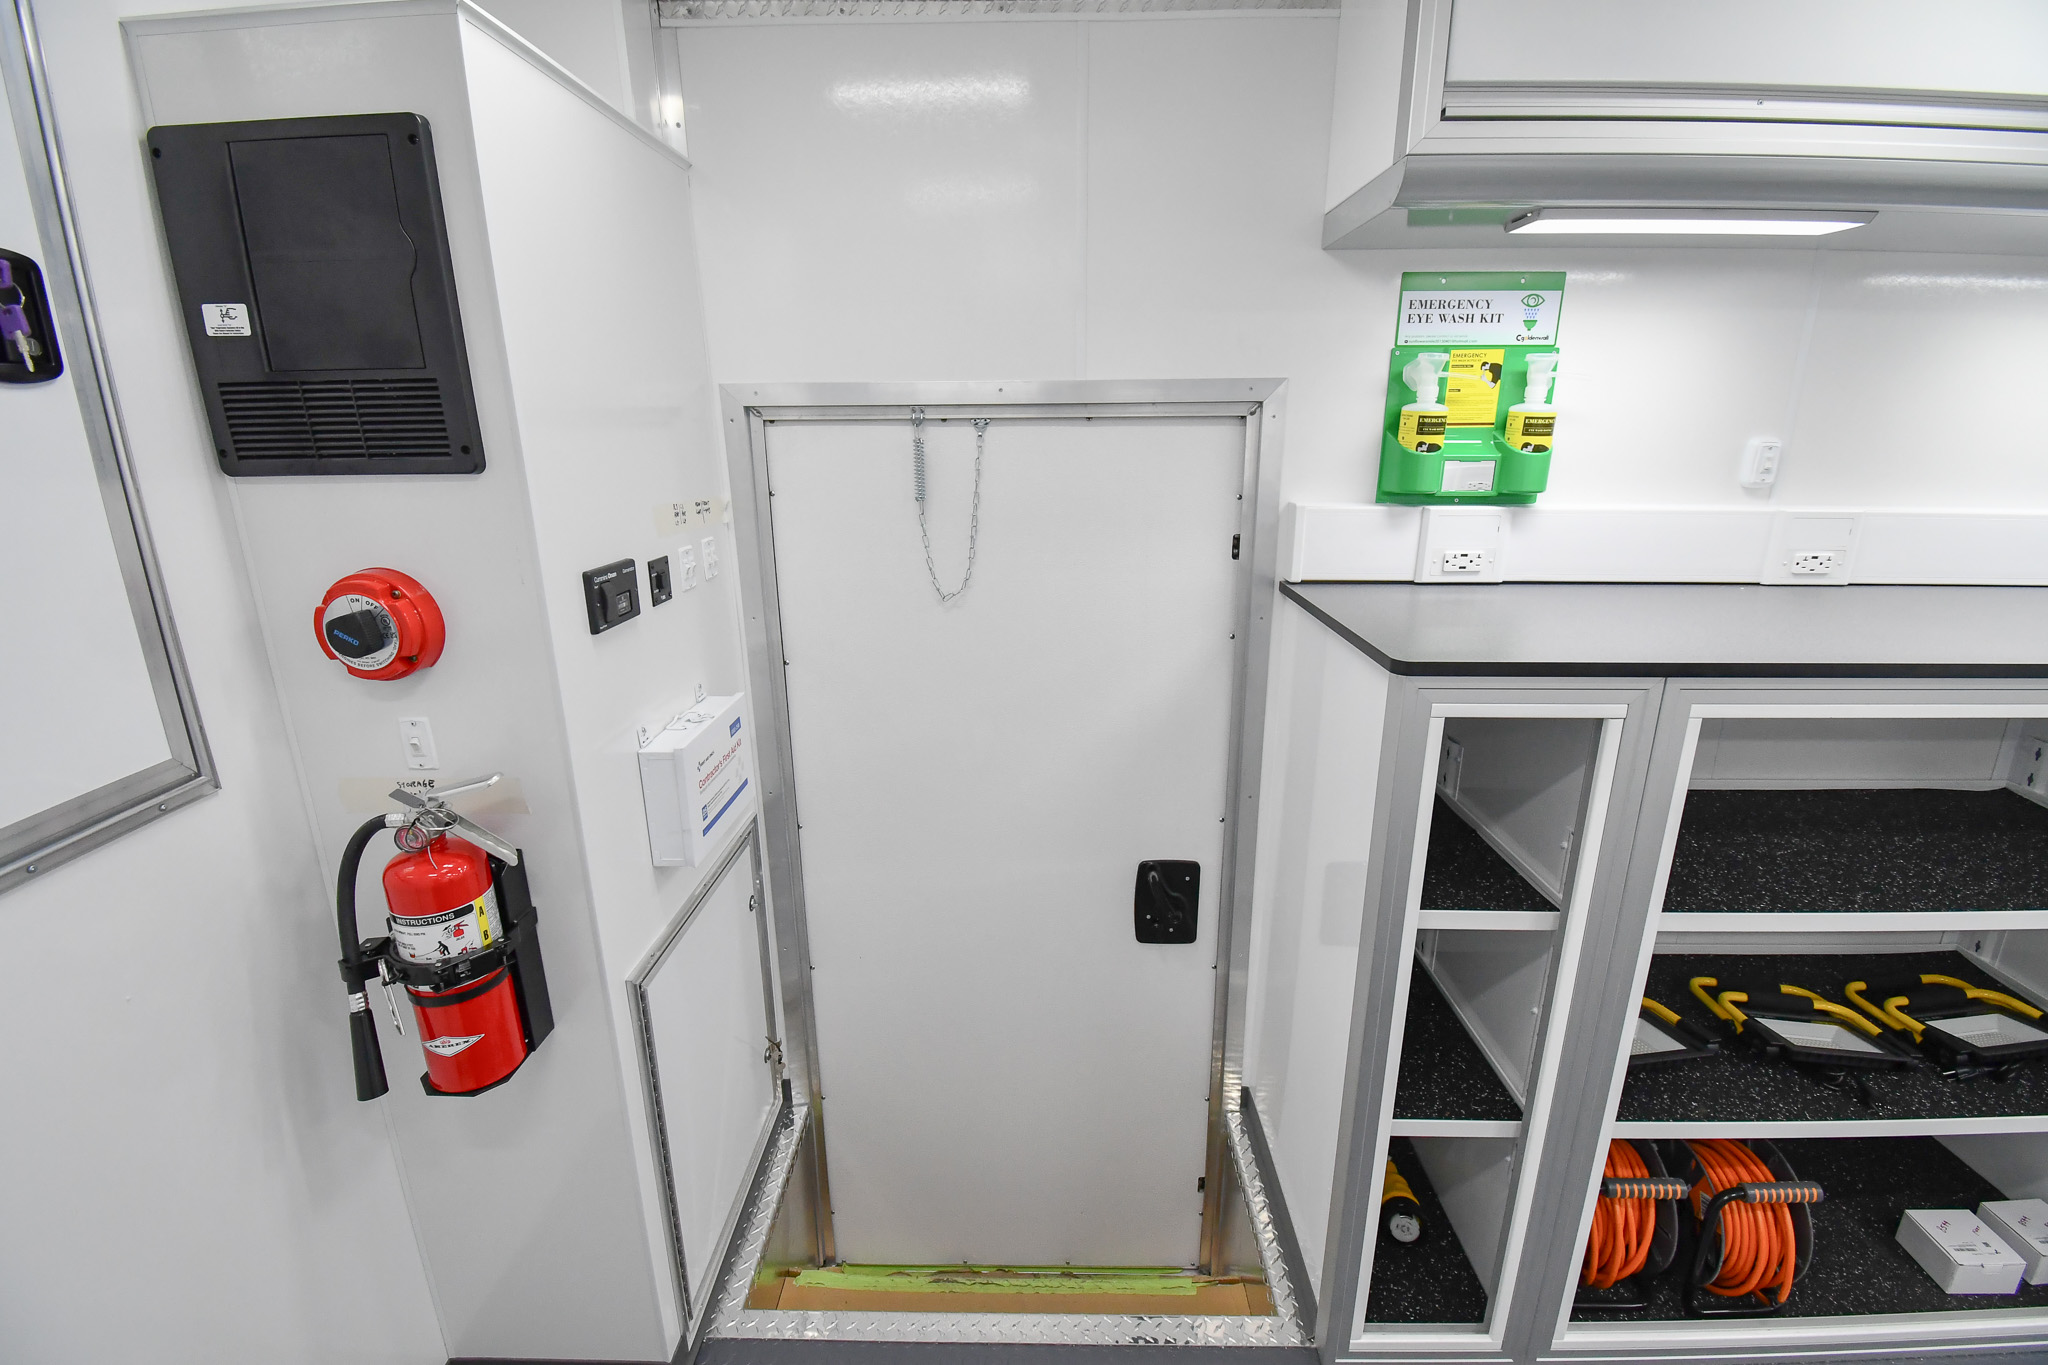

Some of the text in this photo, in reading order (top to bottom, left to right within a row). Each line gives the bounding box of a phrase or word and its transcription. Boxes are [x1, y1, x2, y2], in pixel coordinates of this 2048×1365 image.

[1408, 299, 1494, 310] EMERGENCY
[1407, 313, 1505, 324] EYE WASH KIT
[365, 600, 378, 609] OFF
[333, 629, 359, 646] PERKO
[722, 750, 731, 763] First
[396, 779, 435, 789] STORAGE
[478, 906, 485, 917] A
[396, 912, 455, 926] INSTRUCTIONS
[483, 929, 490, 941] B
